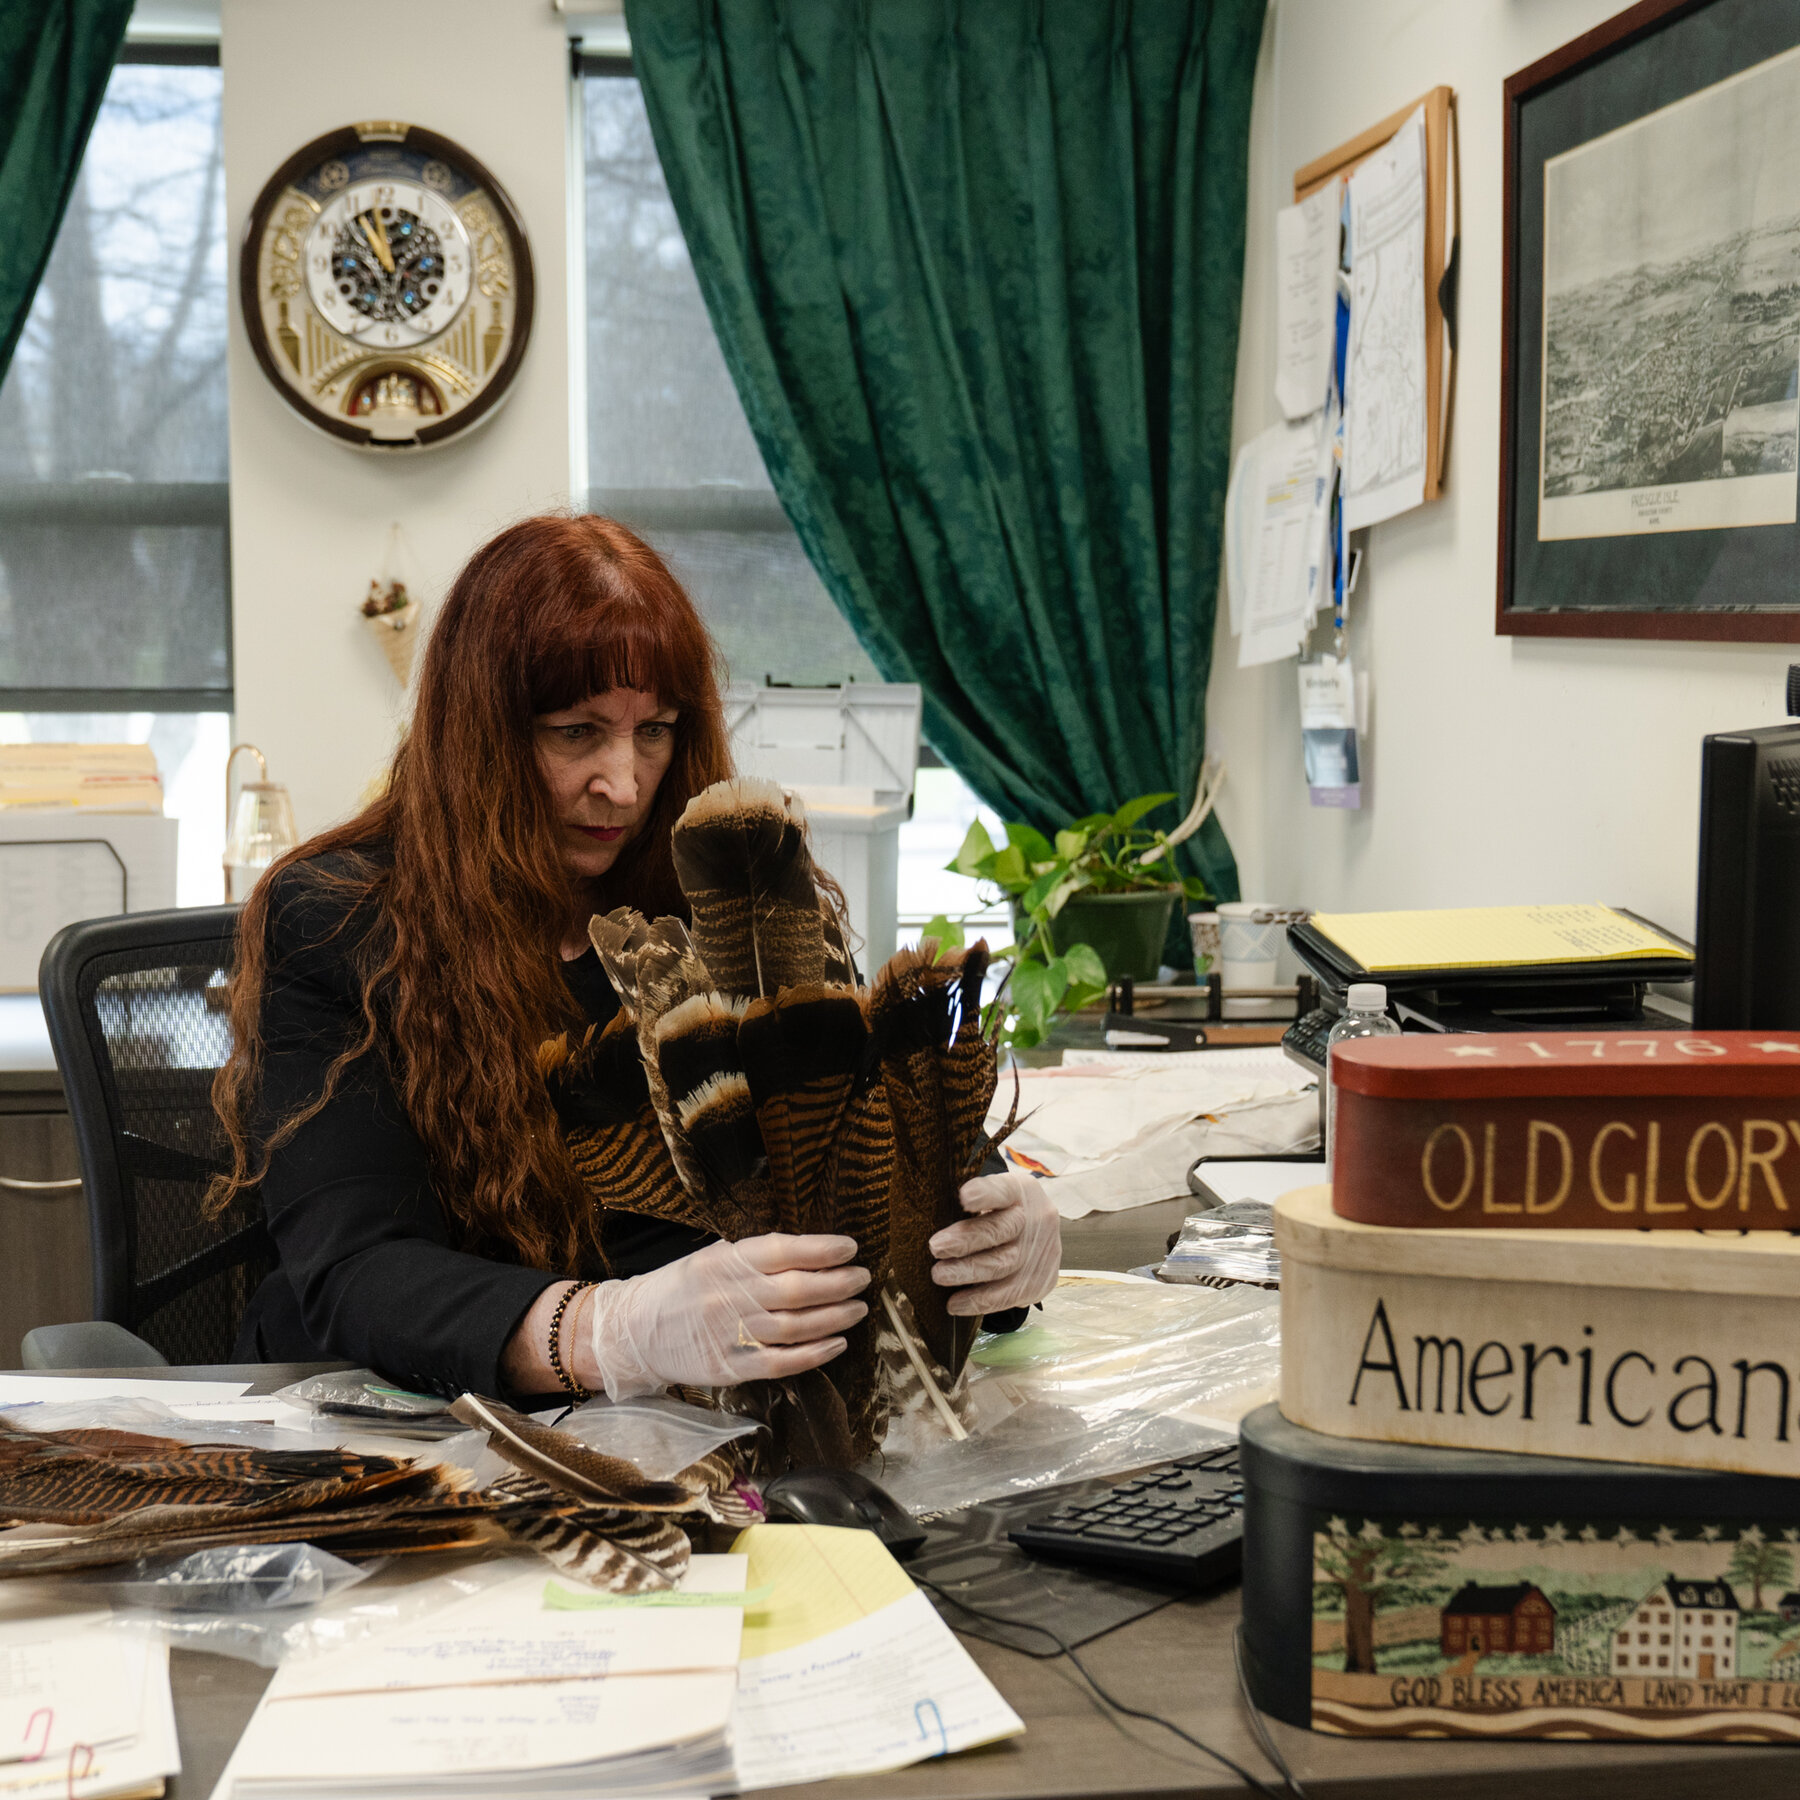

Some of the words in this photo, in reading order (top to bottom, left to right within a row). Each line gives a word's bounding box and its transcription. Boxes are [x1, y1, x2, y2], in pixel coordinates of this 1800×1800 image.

[1519, 1039, 1728, 1060] 1776
[1421, 1119, 1574, 1214] OLD
[1348, 1297, 1800, 1443] American
[1389, 1677, 1442, 1708] GOD
[1451, 1677, 1521, 1708] BLESS
[1532, 1677, 1625, 1707] AMERICA
[1642, 1680, 1695, 1708] LAND
[1701, 1681, 1751, 1707] THAT
[1760, 1683, 1772, 1708] I
